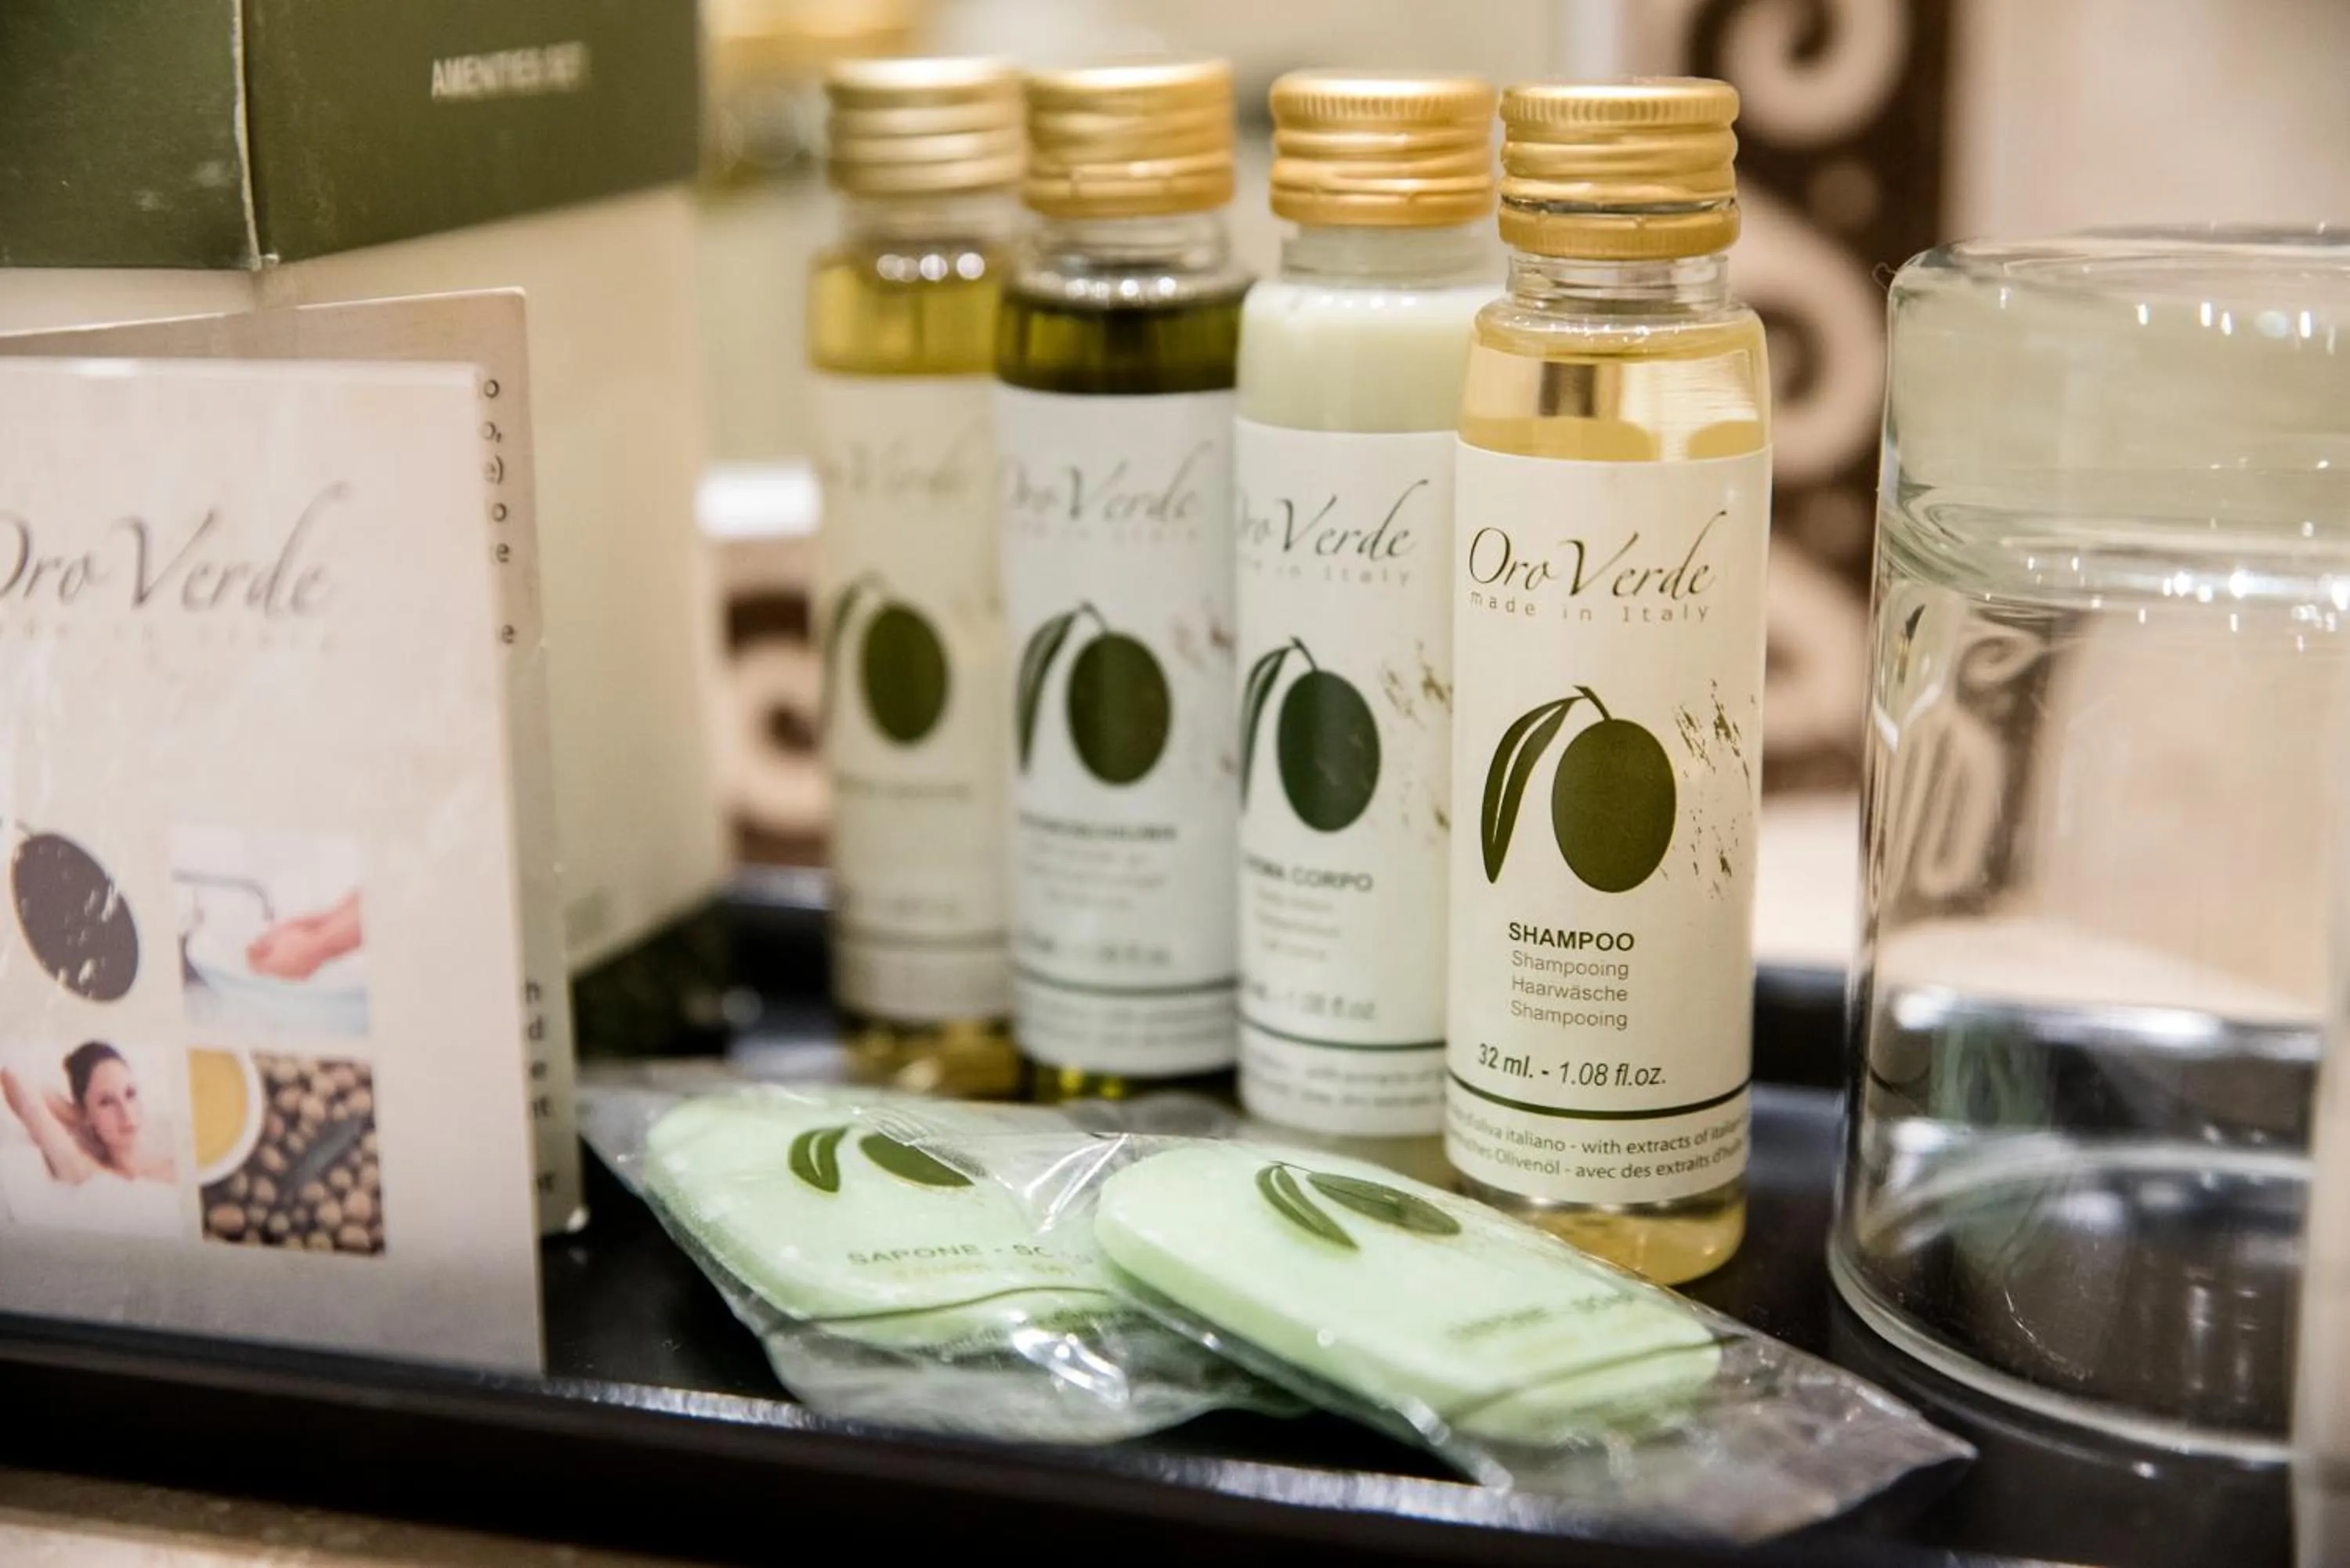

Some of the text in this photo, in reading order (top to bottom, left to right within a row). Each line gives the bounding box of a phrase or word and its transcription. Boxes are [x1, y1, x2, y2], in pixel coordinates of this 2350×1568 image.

[1275, 479, 1429, 562] Verde
[110, 479, 351, 617] Verde
[1469, 511, 1726, 601] Oro Verde
[1470, 590, 1709, 623] made in Italy
[1292, 867, 1374, 892] CORPO
[1509, 921, 1636, 952] SHAMPOO
[1512, 950, 1629, 981] Shampooing
[1512, 976, 1629, 1002] Haarwäsche
[1510, 1000, 1629, 1031] Shampooing
[1478, 1043, 1499, 1070] 32
[1503, 1055, 1534, 1079] ml.
[1560, 1061, 1609, 1086] 1.08
[1505, 1126, 1567, 1153] italiano
[1582, 1140, 1622, 1155] with
[1626, 1134, 1691, 1154] extracts
[1694, 1129, 1708, 1146] of
[1575, 1165, 1617, 1179] avec
[1620, 1162, 1652, 1179] des
[1655, 1153, 1711, 1176] extraits
[846, 1243, 983, 1266] SAPONE
